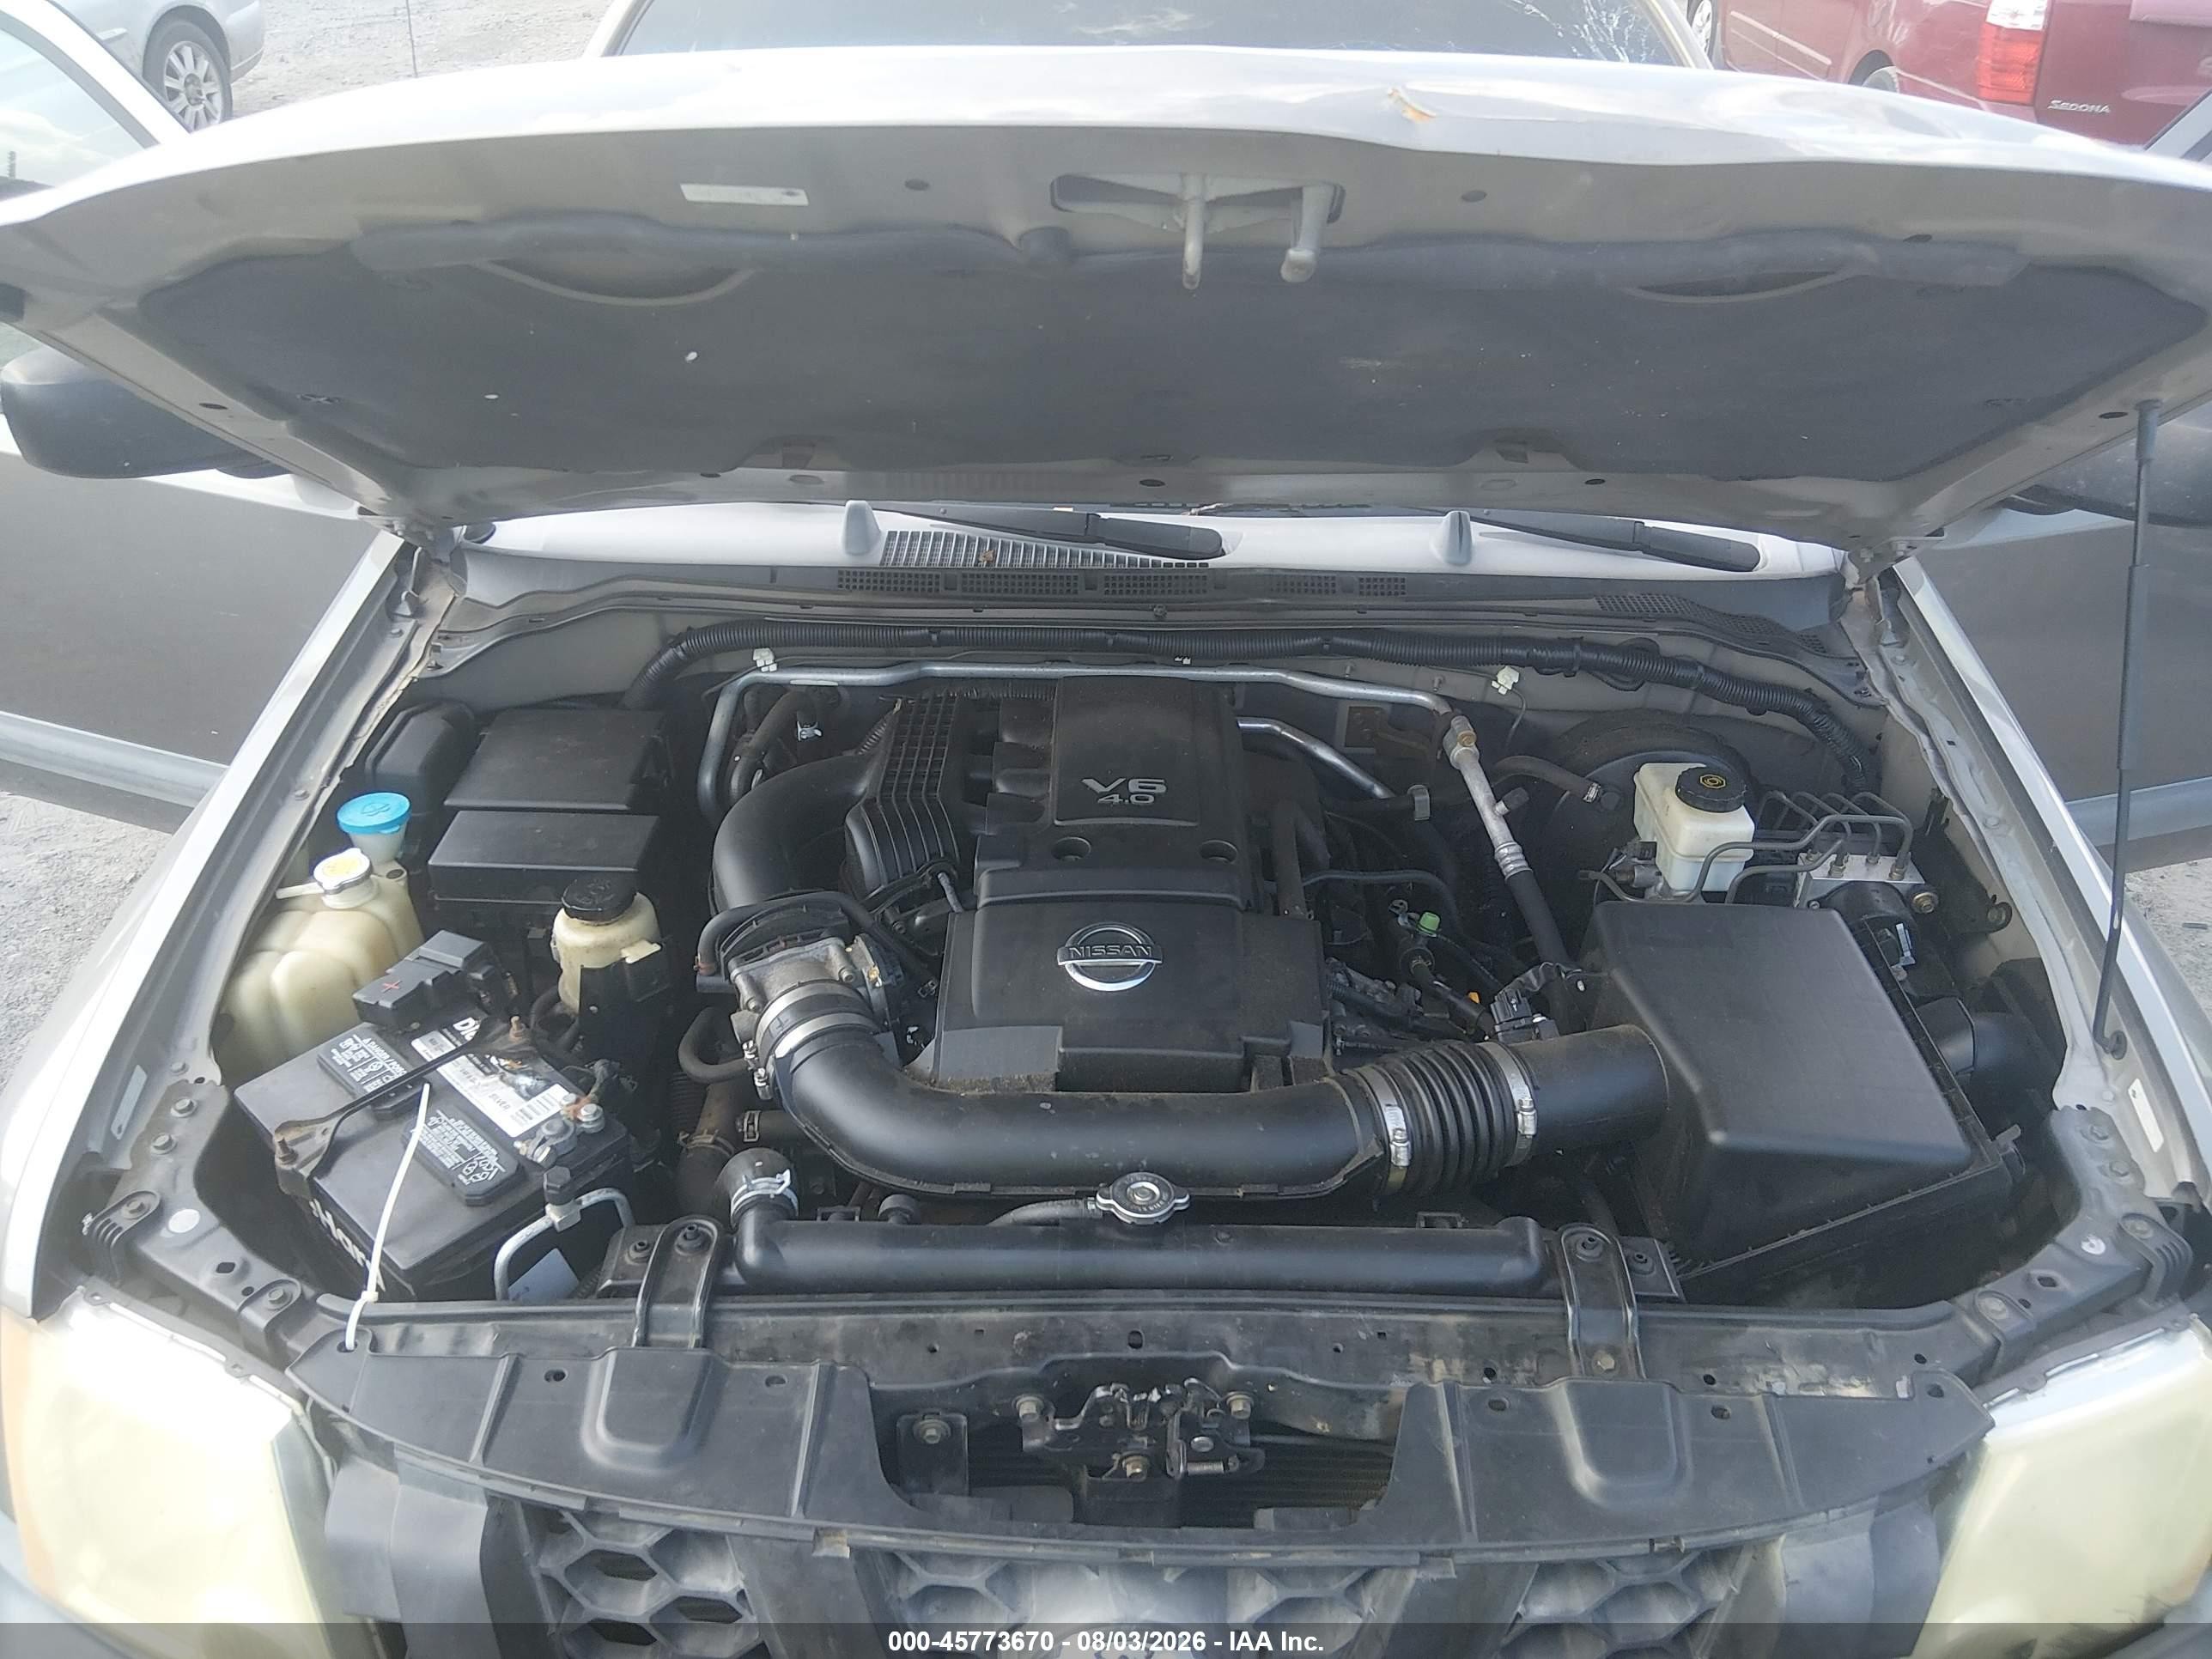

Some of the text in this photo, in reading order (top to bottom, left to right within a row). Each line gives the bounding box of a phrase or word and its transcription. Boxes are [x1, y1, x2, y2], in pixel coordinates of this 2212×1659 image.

[2047, 100, 2111, 113] SEDONA
[1081, 778, 1167, 793] V6
[1097, 793, 1155, 805] 4.0
[1068, 945, 1152, 958] NISSAN
